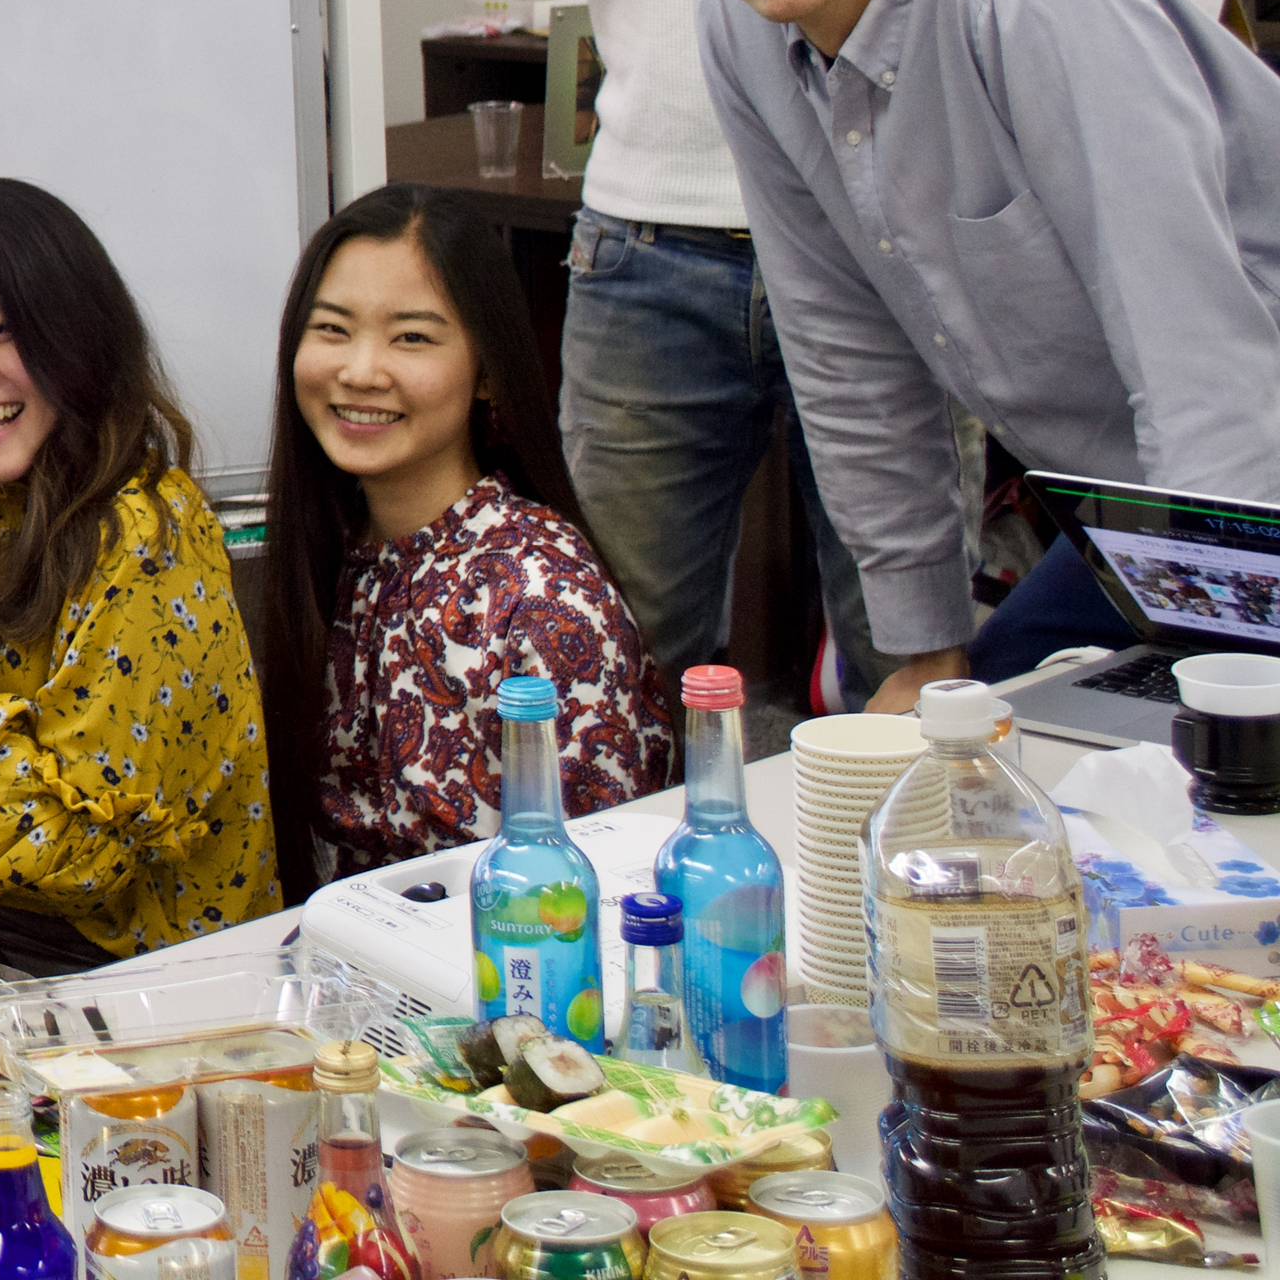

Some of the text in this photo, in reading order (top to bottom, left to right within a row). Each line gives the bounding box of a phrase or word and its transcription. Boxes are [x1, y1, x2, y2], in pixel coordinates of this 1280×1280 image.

[1181, 925, 1234, 942] Cute
[1021, 1009, 1048, 1020] PET
[799, 1246, 829, 1262] アルミ
